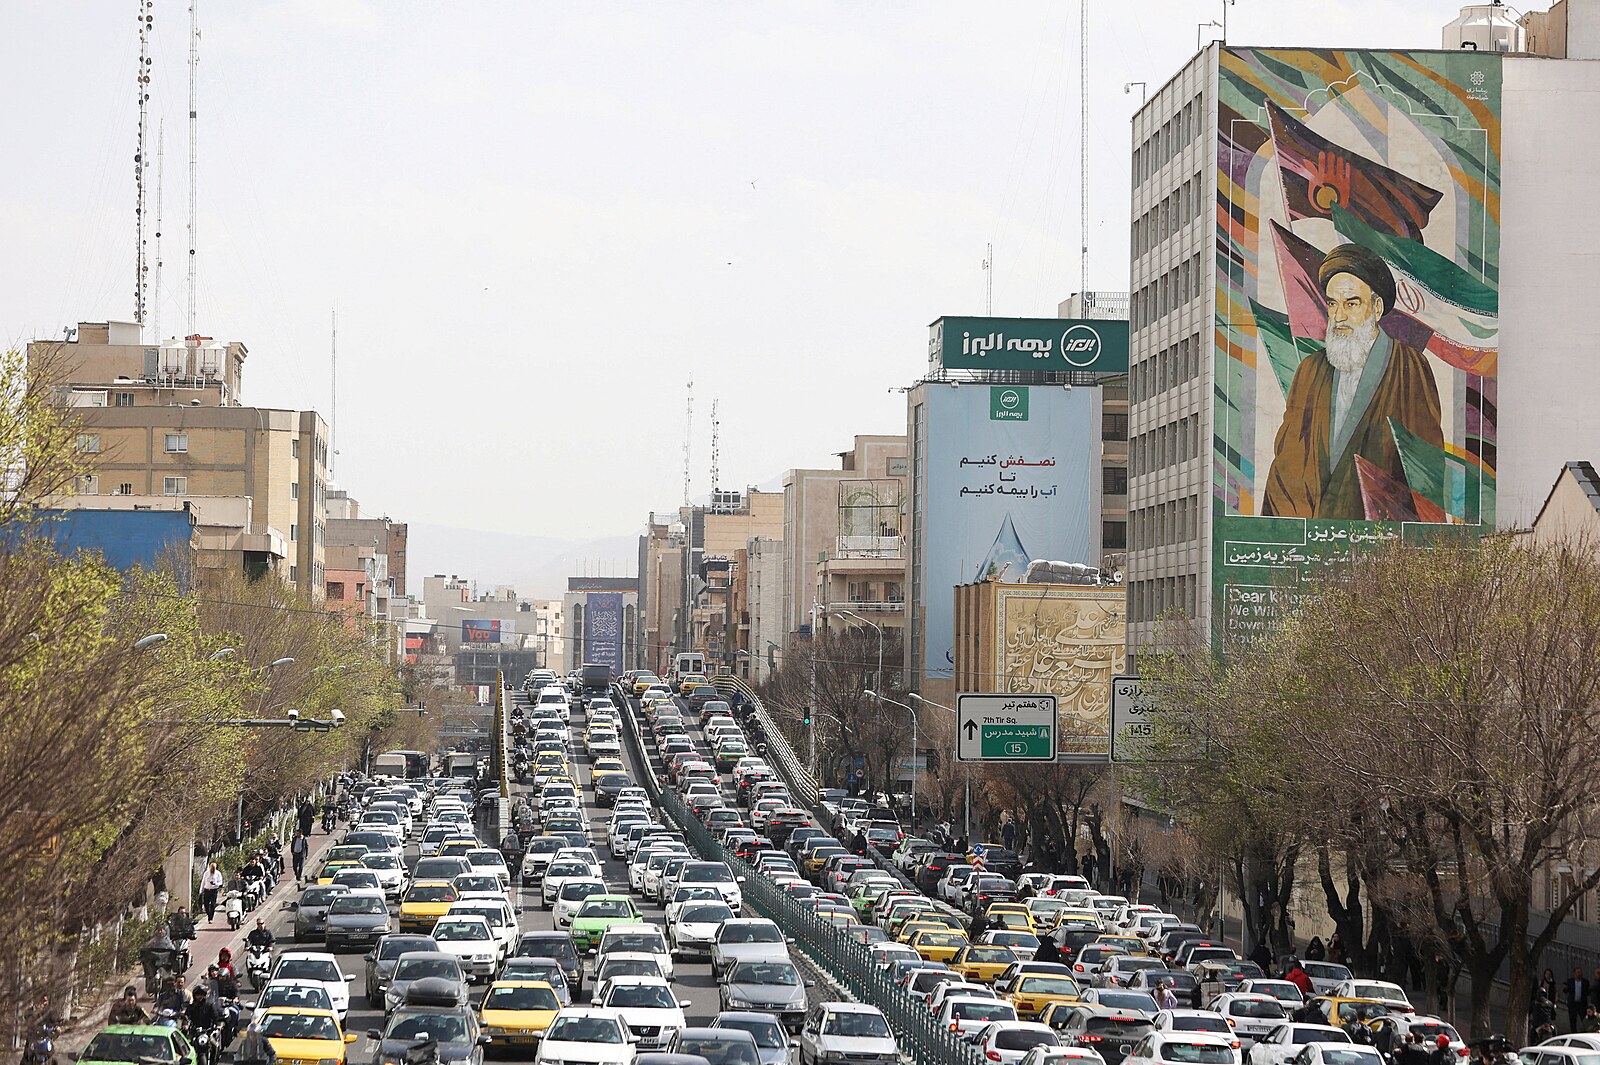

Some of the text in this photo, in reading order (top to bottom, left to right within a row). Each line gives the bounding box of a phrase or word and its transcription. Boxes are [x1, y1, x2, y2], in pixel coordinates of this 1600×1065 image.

[962, 331, 1003, 357] البرز
[1007, 338, 1052, 358] بیمه
[995, 410, 1009, 418] البرز
[959, 454, 1056, 469] نصفش کنیم
[999, 471, 1017, 482] تا
[959, 483, 1058, 499] آب را بیمه کنیم
[1229, 547, 1262, 563] زمین
[1263, 550, 1278, 565] به
[1229, 604, 1249, 616] We
[1002, 701, 1037, 712] هفتم تیر
[983, 716, 1018, 725] 7th Tir Sq.
[984, 727, 1037, 738] شهید مدرس
[1010, 743, 1021, 753] 15
